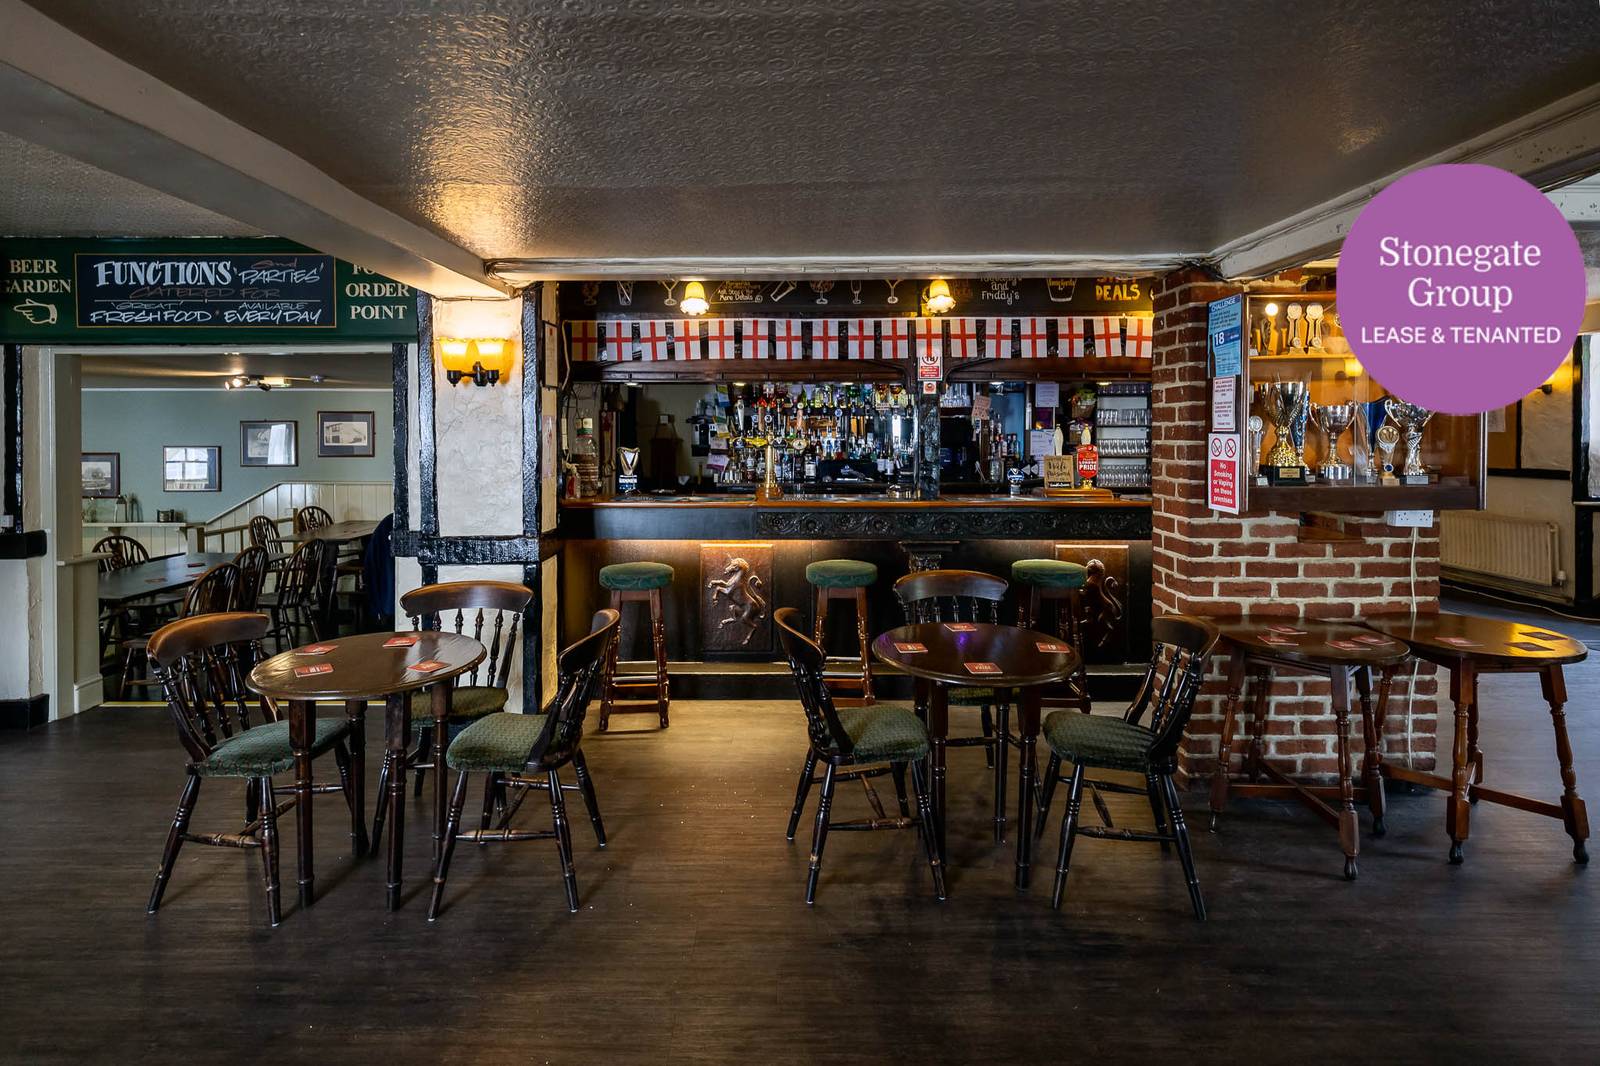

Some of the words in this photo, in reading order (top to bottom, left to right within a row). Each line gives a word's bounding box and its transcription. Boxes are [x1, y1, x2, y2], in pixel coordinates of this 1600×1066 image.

[8, 259, 58, 273] BEER
[93, 260, 232, 287] FUNCTIONS
[0, 279, 72, 293] GARDEN
[129, 286, 235, 300] CATERED
[239, 287, 281, 299] FOR
[345, 282, 410, 297] ORDER
[991, 281, 1009, 291] and
[1095, 283, 1141, 301] DEALS
[981, 290, 1020, 305] Friday's
[1211, 297, 1236, 312] CHALLENGE
[238, 302, 309, 311] AVAILABLE
[350, 305, 408, 320] POINT
[90, 310, 161, 323] FRESH
[163, 310, 212, 322] FOOD
[1214, 331, 1225, 346] 18
[1213, 470, 1233, 480] Smoking
